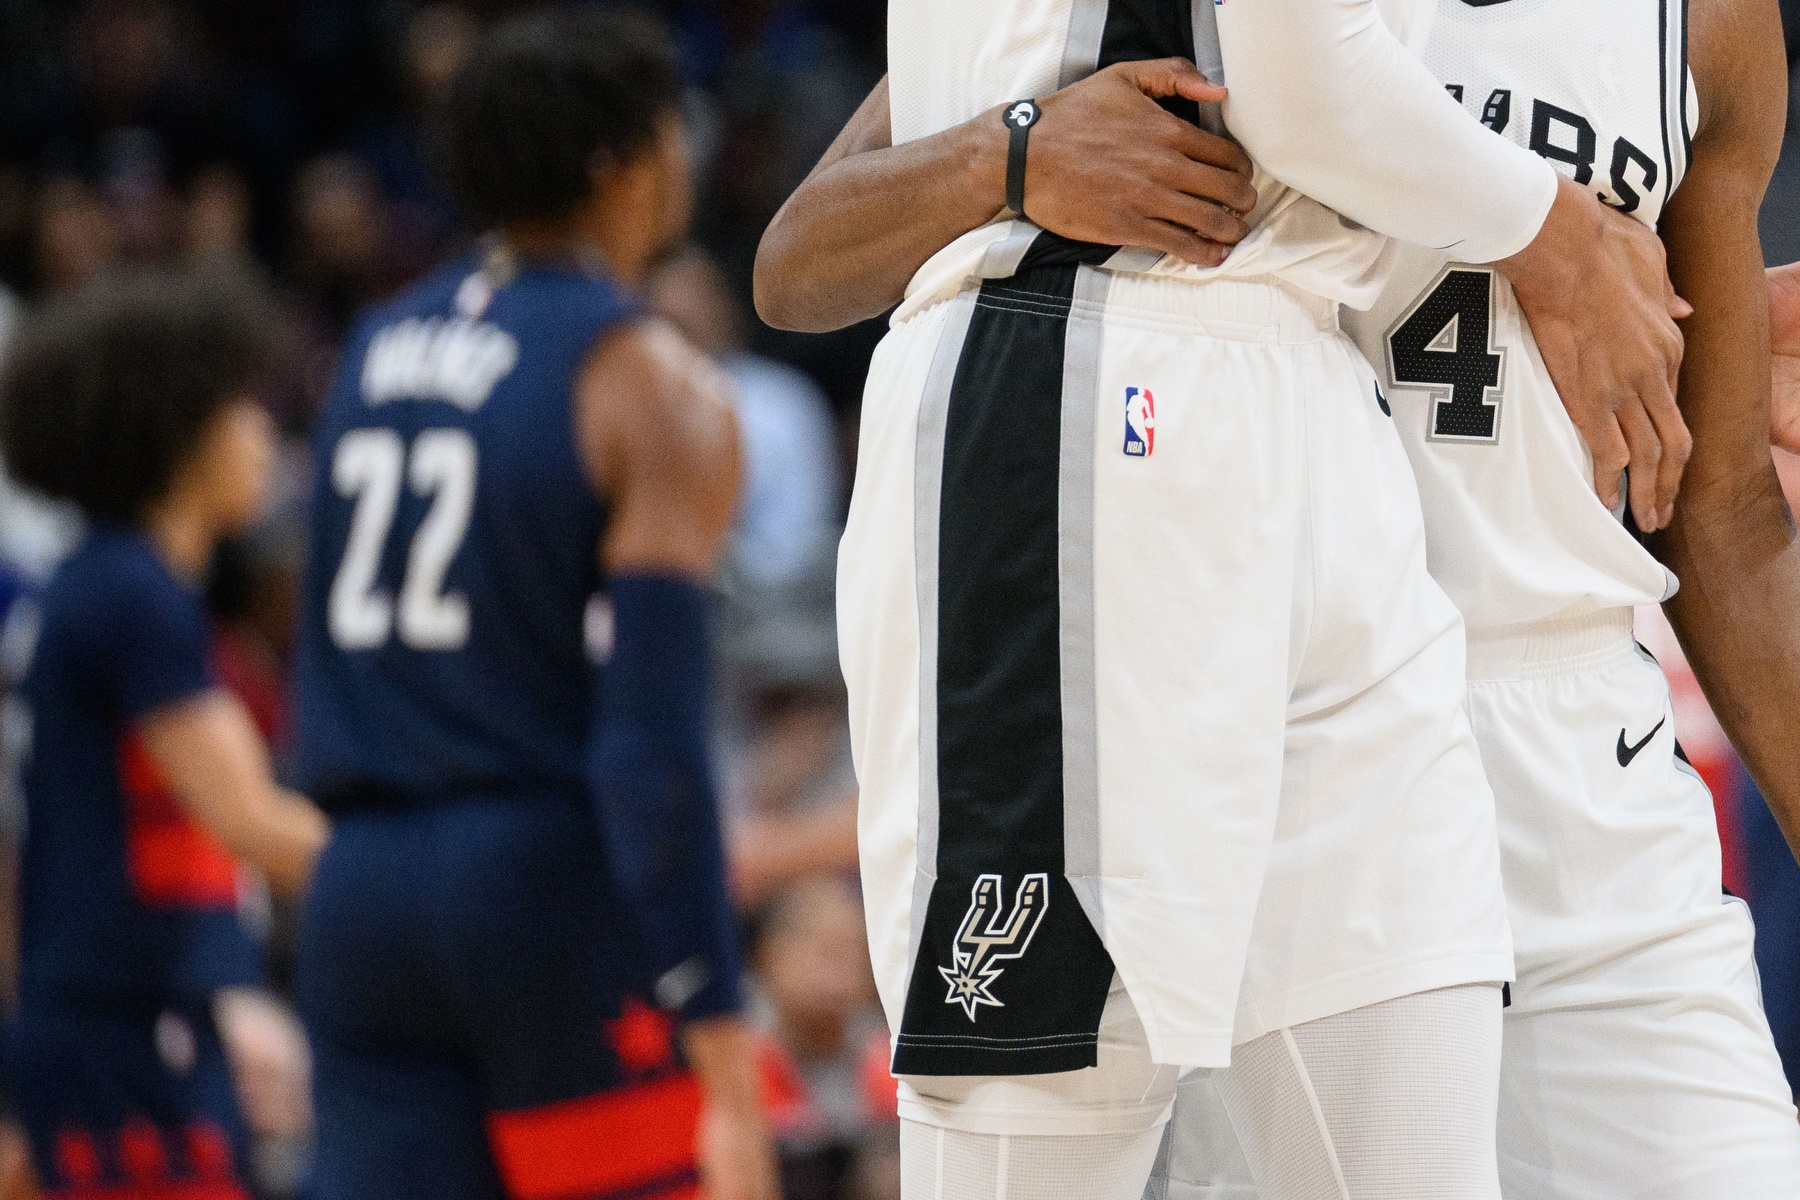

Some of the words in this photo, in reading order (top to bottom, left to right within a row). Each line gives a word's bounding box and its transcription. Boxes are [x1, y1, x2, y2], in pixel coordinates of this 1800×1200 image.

[1384, 262, 1507, 445] 4
[1126, 441, 1143, 454] NBA
[328, 428, 478, 651] 22
